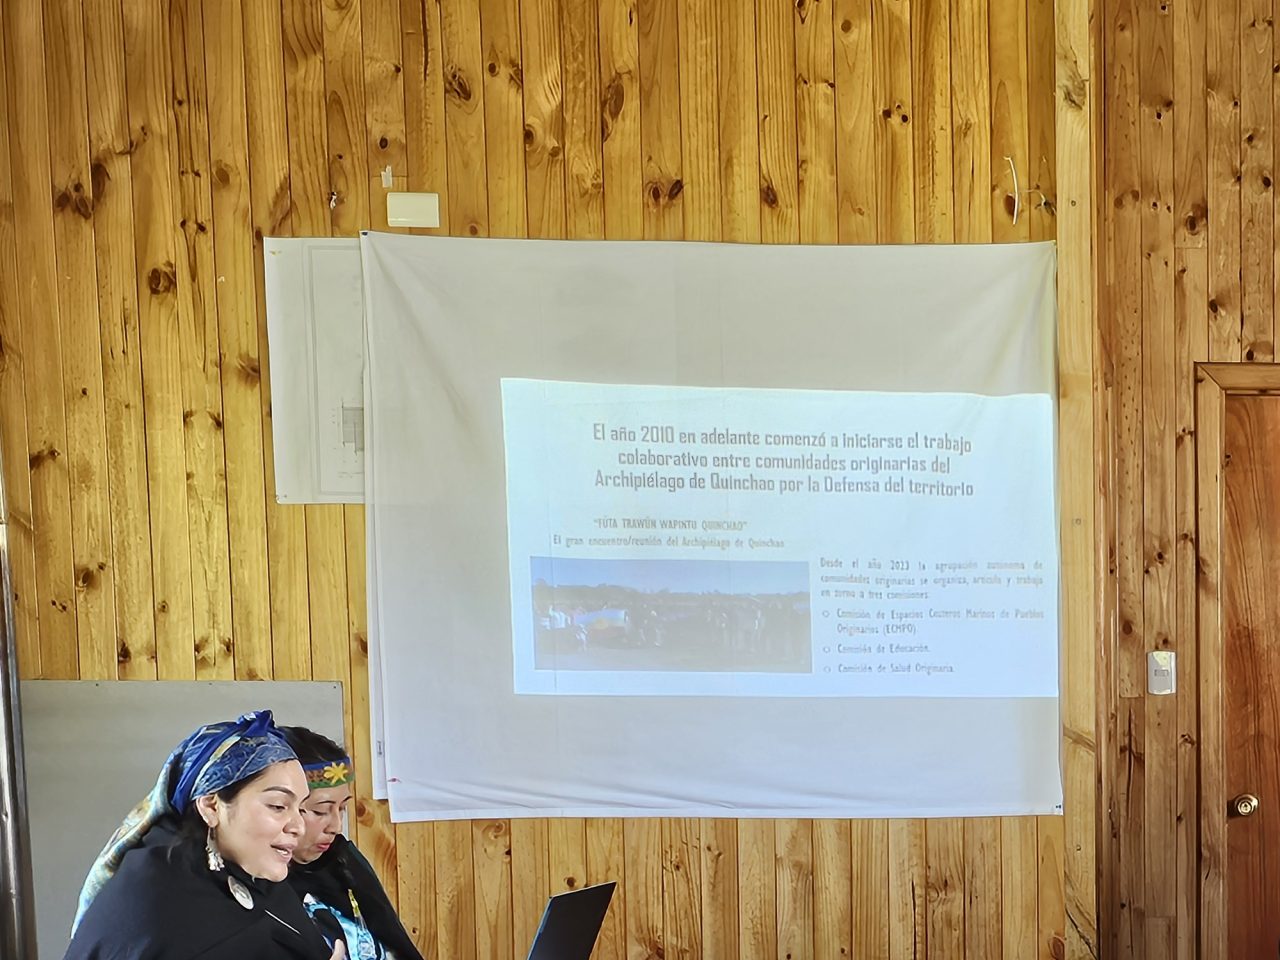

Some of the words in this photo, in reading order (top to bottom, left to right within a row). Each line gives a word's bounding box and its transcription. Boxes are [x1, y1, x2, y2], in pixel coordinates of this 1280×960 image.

[593, 423, 606, 441] El
[610, 427, 636, 442] año
[641, 425, 675, 443] 2010
[679, 432, 696, 444] en
[700, 427, 760, 445] adelante
[764, 431, 826, 447] comenzó
[831, 435, 839, 447] a
[843, 432, 903, 449] iniciarse
[907, 431, 919, 449] el
[924, 432, 972, 456] trabajo
[618, 448, 708, 468] colaborativo
[712, 454, 751, 468] entre
[755, 453, 846, 471] comunidades
[850, 455, 927, 475] originarias
[931, 455, 951, 474] del
[595, 470, 685, 492] Archipiélago
[689, 472, 706, 489] de
[710, 473, 775, 491] Quinchao
[779, 478, 803, 495] por
[808, 475, 820, 492] la
[824, 475, 880, 493] Defensa
[884, 476, 904, 493] del
[909, 479, 974, 496] territorio
[553, 535, 562, 545] El
[566, 537, 584, 548] gran
[666, 535, 679, 548] del
[735, 538, 744, 548] de
[820, 557, 843, 568] Desde
[852, 558, 859, 569] el
[868, 558, 882, 569] año
[918, 560, 926, 570] la
[1033, 560, 1043, 570] de
[920, 577, 928, 585] se
[1006, 578, 1012, 588] y
[876, 609, 886, 619] de
[1000, 608, 1010, 618] de
[876, 643, 886, 653] de
[877, 663, 887, 673] de
